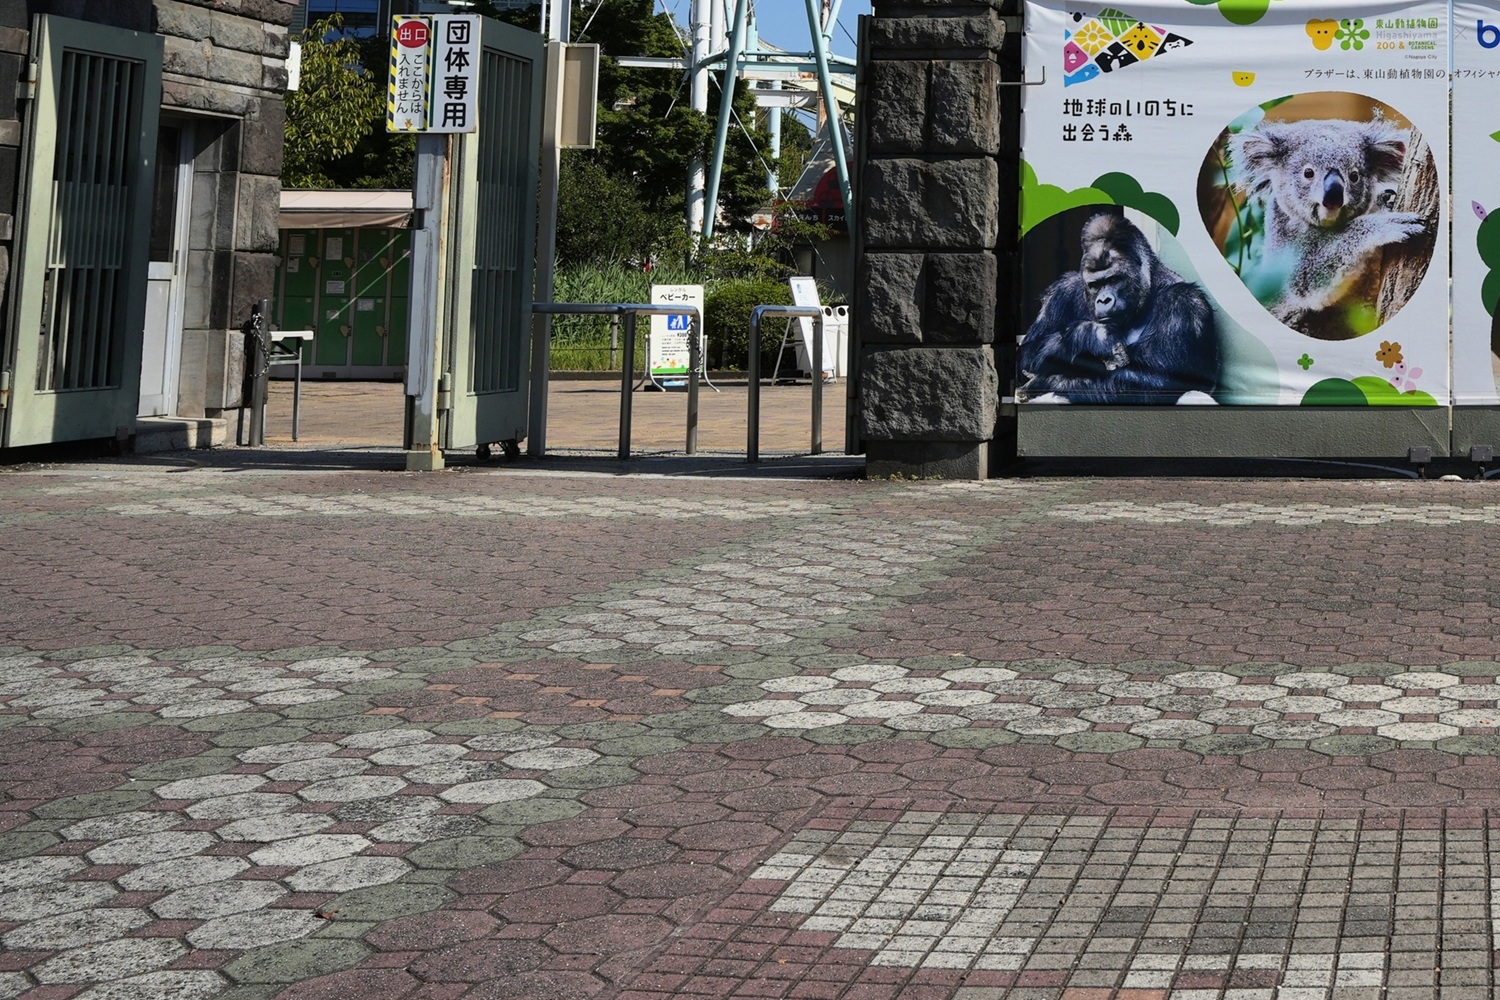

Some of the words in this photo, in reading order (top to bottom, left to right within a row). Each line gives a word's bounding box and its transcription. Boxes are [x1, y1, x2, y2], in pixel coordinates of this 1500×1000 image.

[1375, 18, 1438, 29] 東山動植物園
[399, 28, 427, 42] 出口
[1376, 31, 1438, 40] Higashiyama
[1376, 42, 1396, 50] ZOO
[1398, 42, 1405, 50] &
[441, 20, 472, 128] 団体専用
[396, 53, 411, 114] 入れません
[410, 53, 424, 114] ここからは
[1063, 98, 1194, 117] 地球のいのちに
[1063, 123, 1134, 143] 出会う森
[660, 293, 696, 301] ベビーカー
